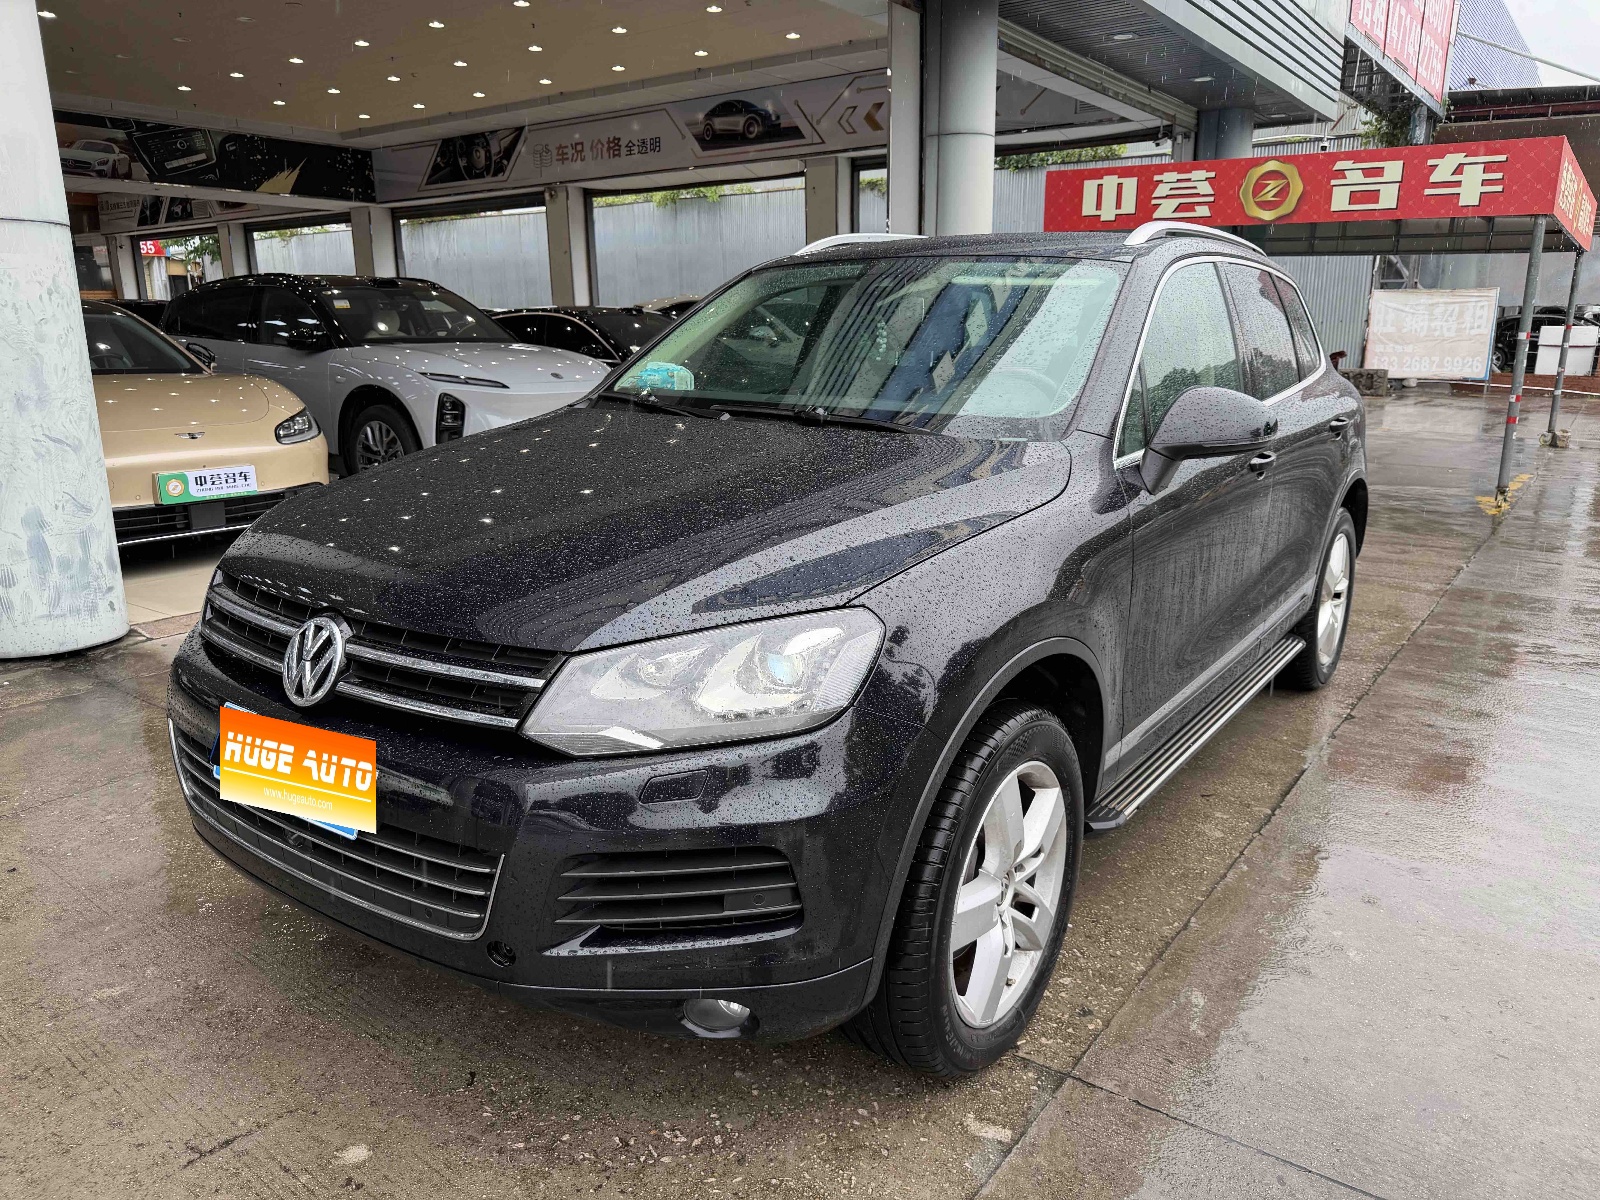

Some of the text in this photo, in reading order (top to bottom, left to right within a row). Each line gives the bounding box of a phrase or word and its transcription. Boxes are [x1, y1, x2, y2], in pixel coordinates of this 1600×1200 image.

[555, 136, 661, 165] 车况 价格 全透明
[1081, 170, 1215, 221] 中荟
[1330, 152, 1508, 212] 名车
[1402, 356, 1440, 373] 2687
[194, 471, 251, 487] 中荟名车
